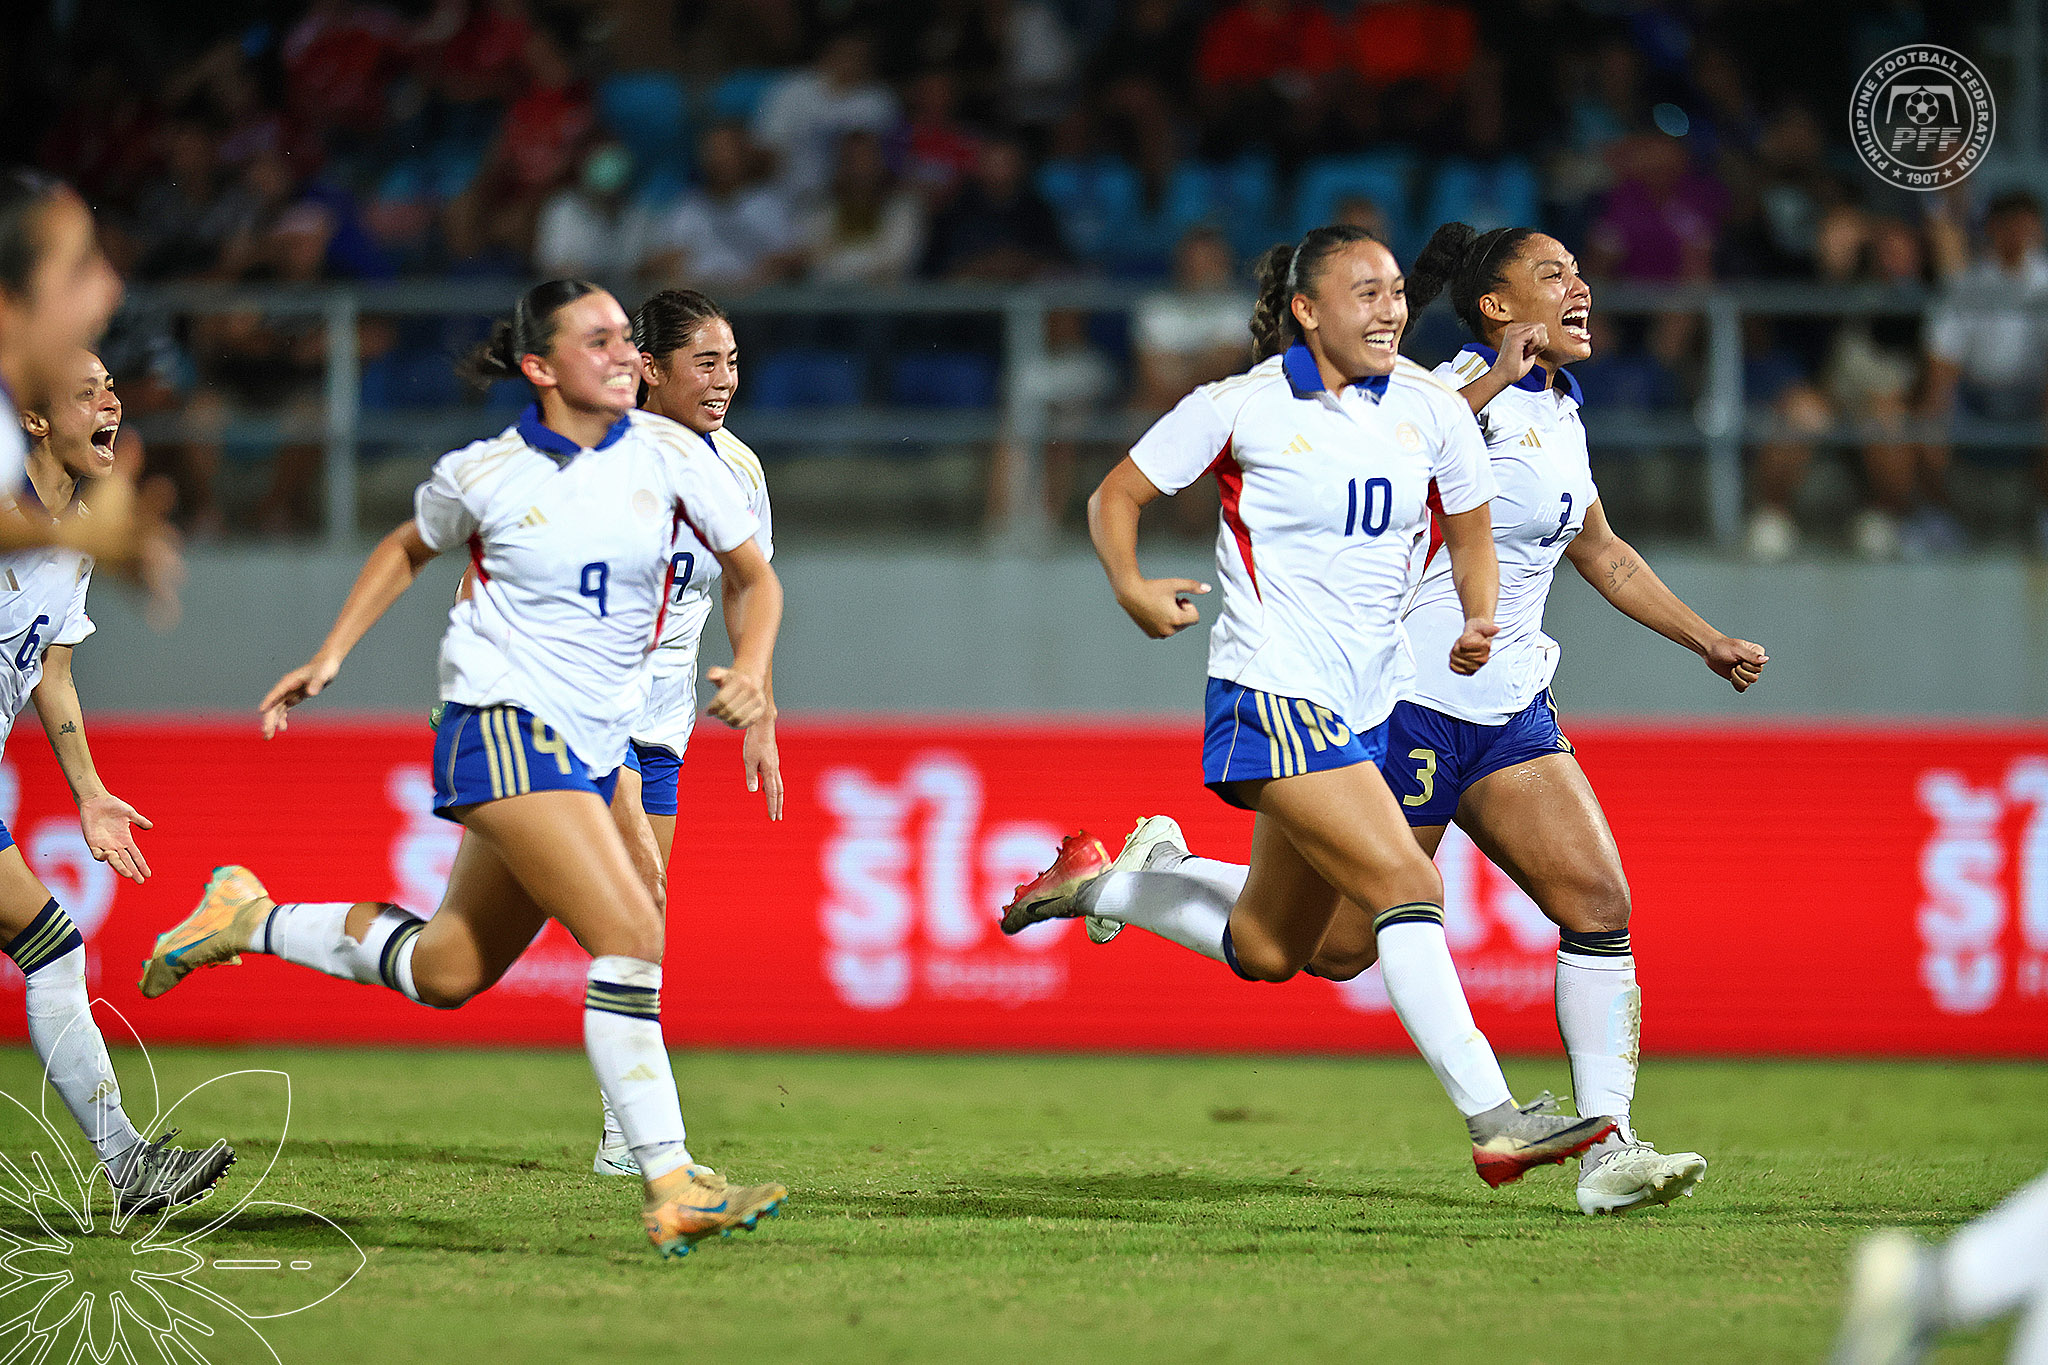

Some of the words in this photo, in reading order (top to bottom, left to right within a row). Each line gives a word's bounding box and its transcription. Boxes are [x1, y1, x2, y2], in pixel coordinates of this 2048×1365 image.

[1344, 477, 1392, 537] 10
[1539, 492, 1573, 547] 3
[580, 561, 609, 617] 9
[671, 552, 695, 603] 9
[15, 614, 50, 671] 6
[1402, 748, 1437, 806] 3
